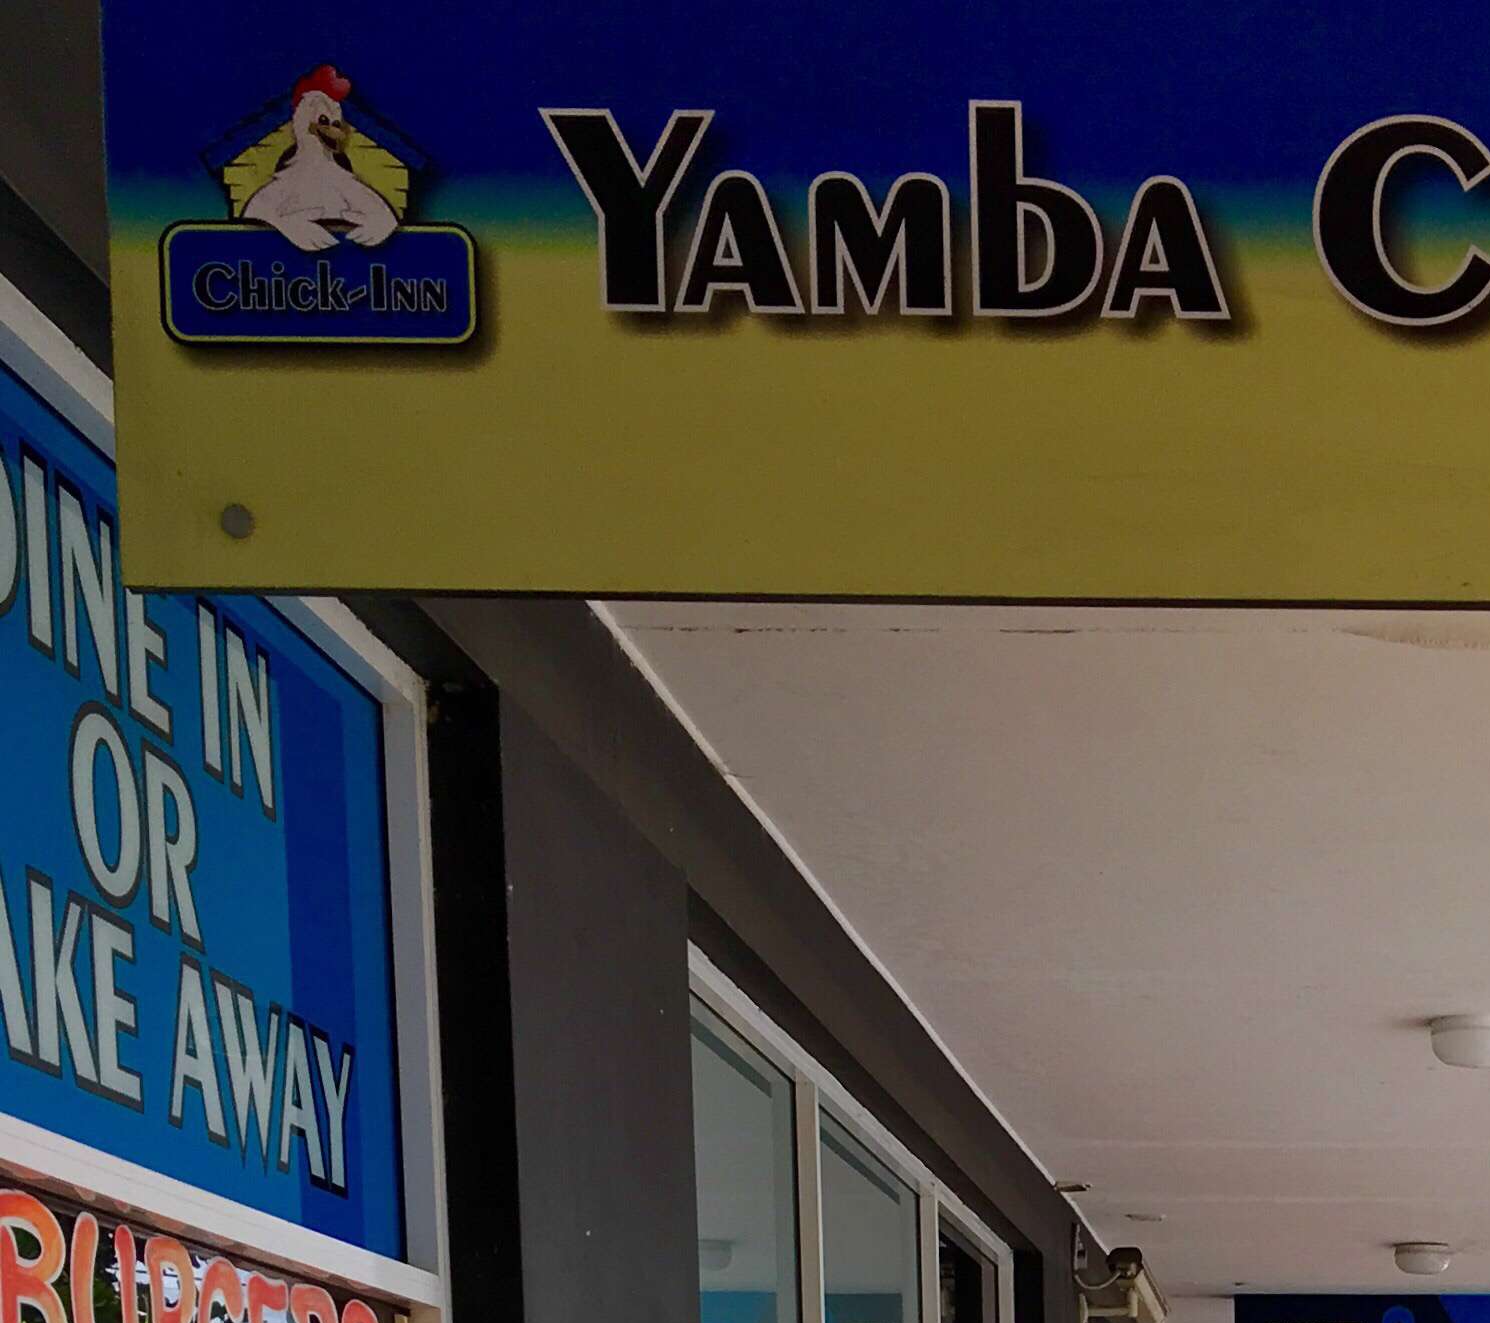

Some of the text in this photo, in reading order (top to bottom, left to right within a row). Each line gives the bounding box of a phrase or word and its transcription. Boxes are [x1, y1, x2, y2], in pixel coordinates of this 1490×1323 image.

[70, 702, 203, 950] OR
[197, 600, 276, 821] IN
[169, 953, 352, 1197] AWAY
